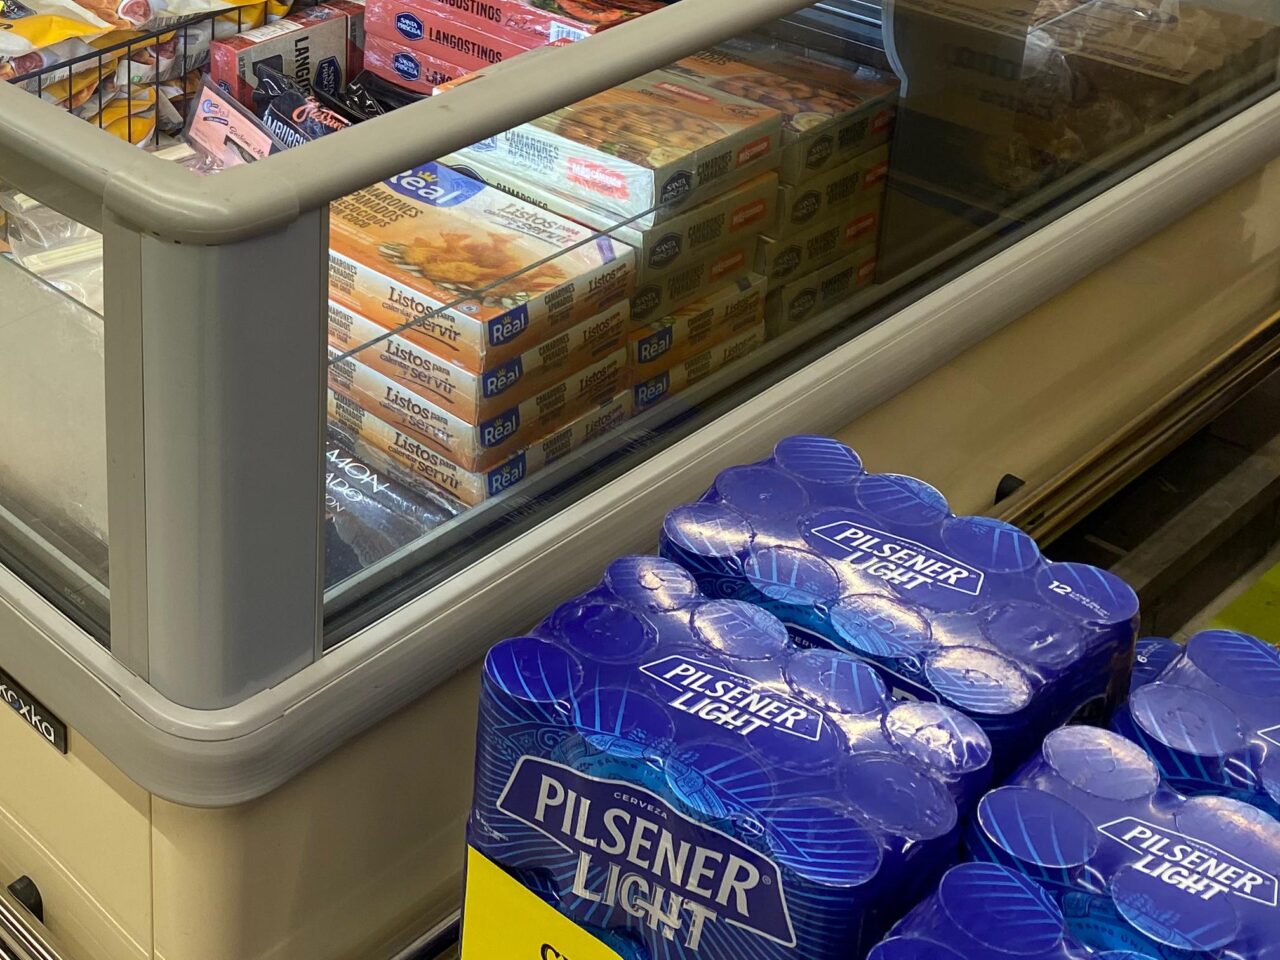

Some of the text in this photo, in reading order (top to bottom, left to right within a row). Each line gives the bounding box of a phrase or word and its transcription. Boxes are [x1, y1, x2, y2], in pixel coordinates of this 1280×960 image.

[397, 22, 422, 36] PRISCILA
[400, 17, 418, 29] SANTA
[428, 26, 503, 64] LANGOSTINOS
[398, 56, 416, 69] SANTA
[365, 185, 424, 219] MARONES
[496, 202, 549, 230] Listos
[588, 269, 616, 293] Listos
[387, 286, 434, 316] Listos
[413, 314, 462, 342] servir
[493, 313, 525, 345] Real
[385, 339, 432, 372] Listos
[641, 333, 670, 361] Real
[410, 367, 457, 395] servir
[487, 365, 519, 395] Real
[638, 377, 667, 403] Real
[384, 386, 430, 420] Listos
[484, 415, 517, 446] Real
[393, 432, 439, 466] Listos
[417, 461, 463, 490] servir
[492, 461, 523, 493] Real
[834, 526, 970, 586] PILSENER
[842, 550, 934, 591] LIGHT
[1048, 580, 1072, 596] 12
[662, 662, 806, 730] PILSENER
[669, 694, 770, 737] LIGHT
[613, 791, 668, 821] CERVEZA
[533, 773, 761, 918] PILSENER
[1121, 825, 1265, 894] PILSENER
[1131, 854, 1230, 901] LIGHT
[571, 850, 718, 952] LIGHT
